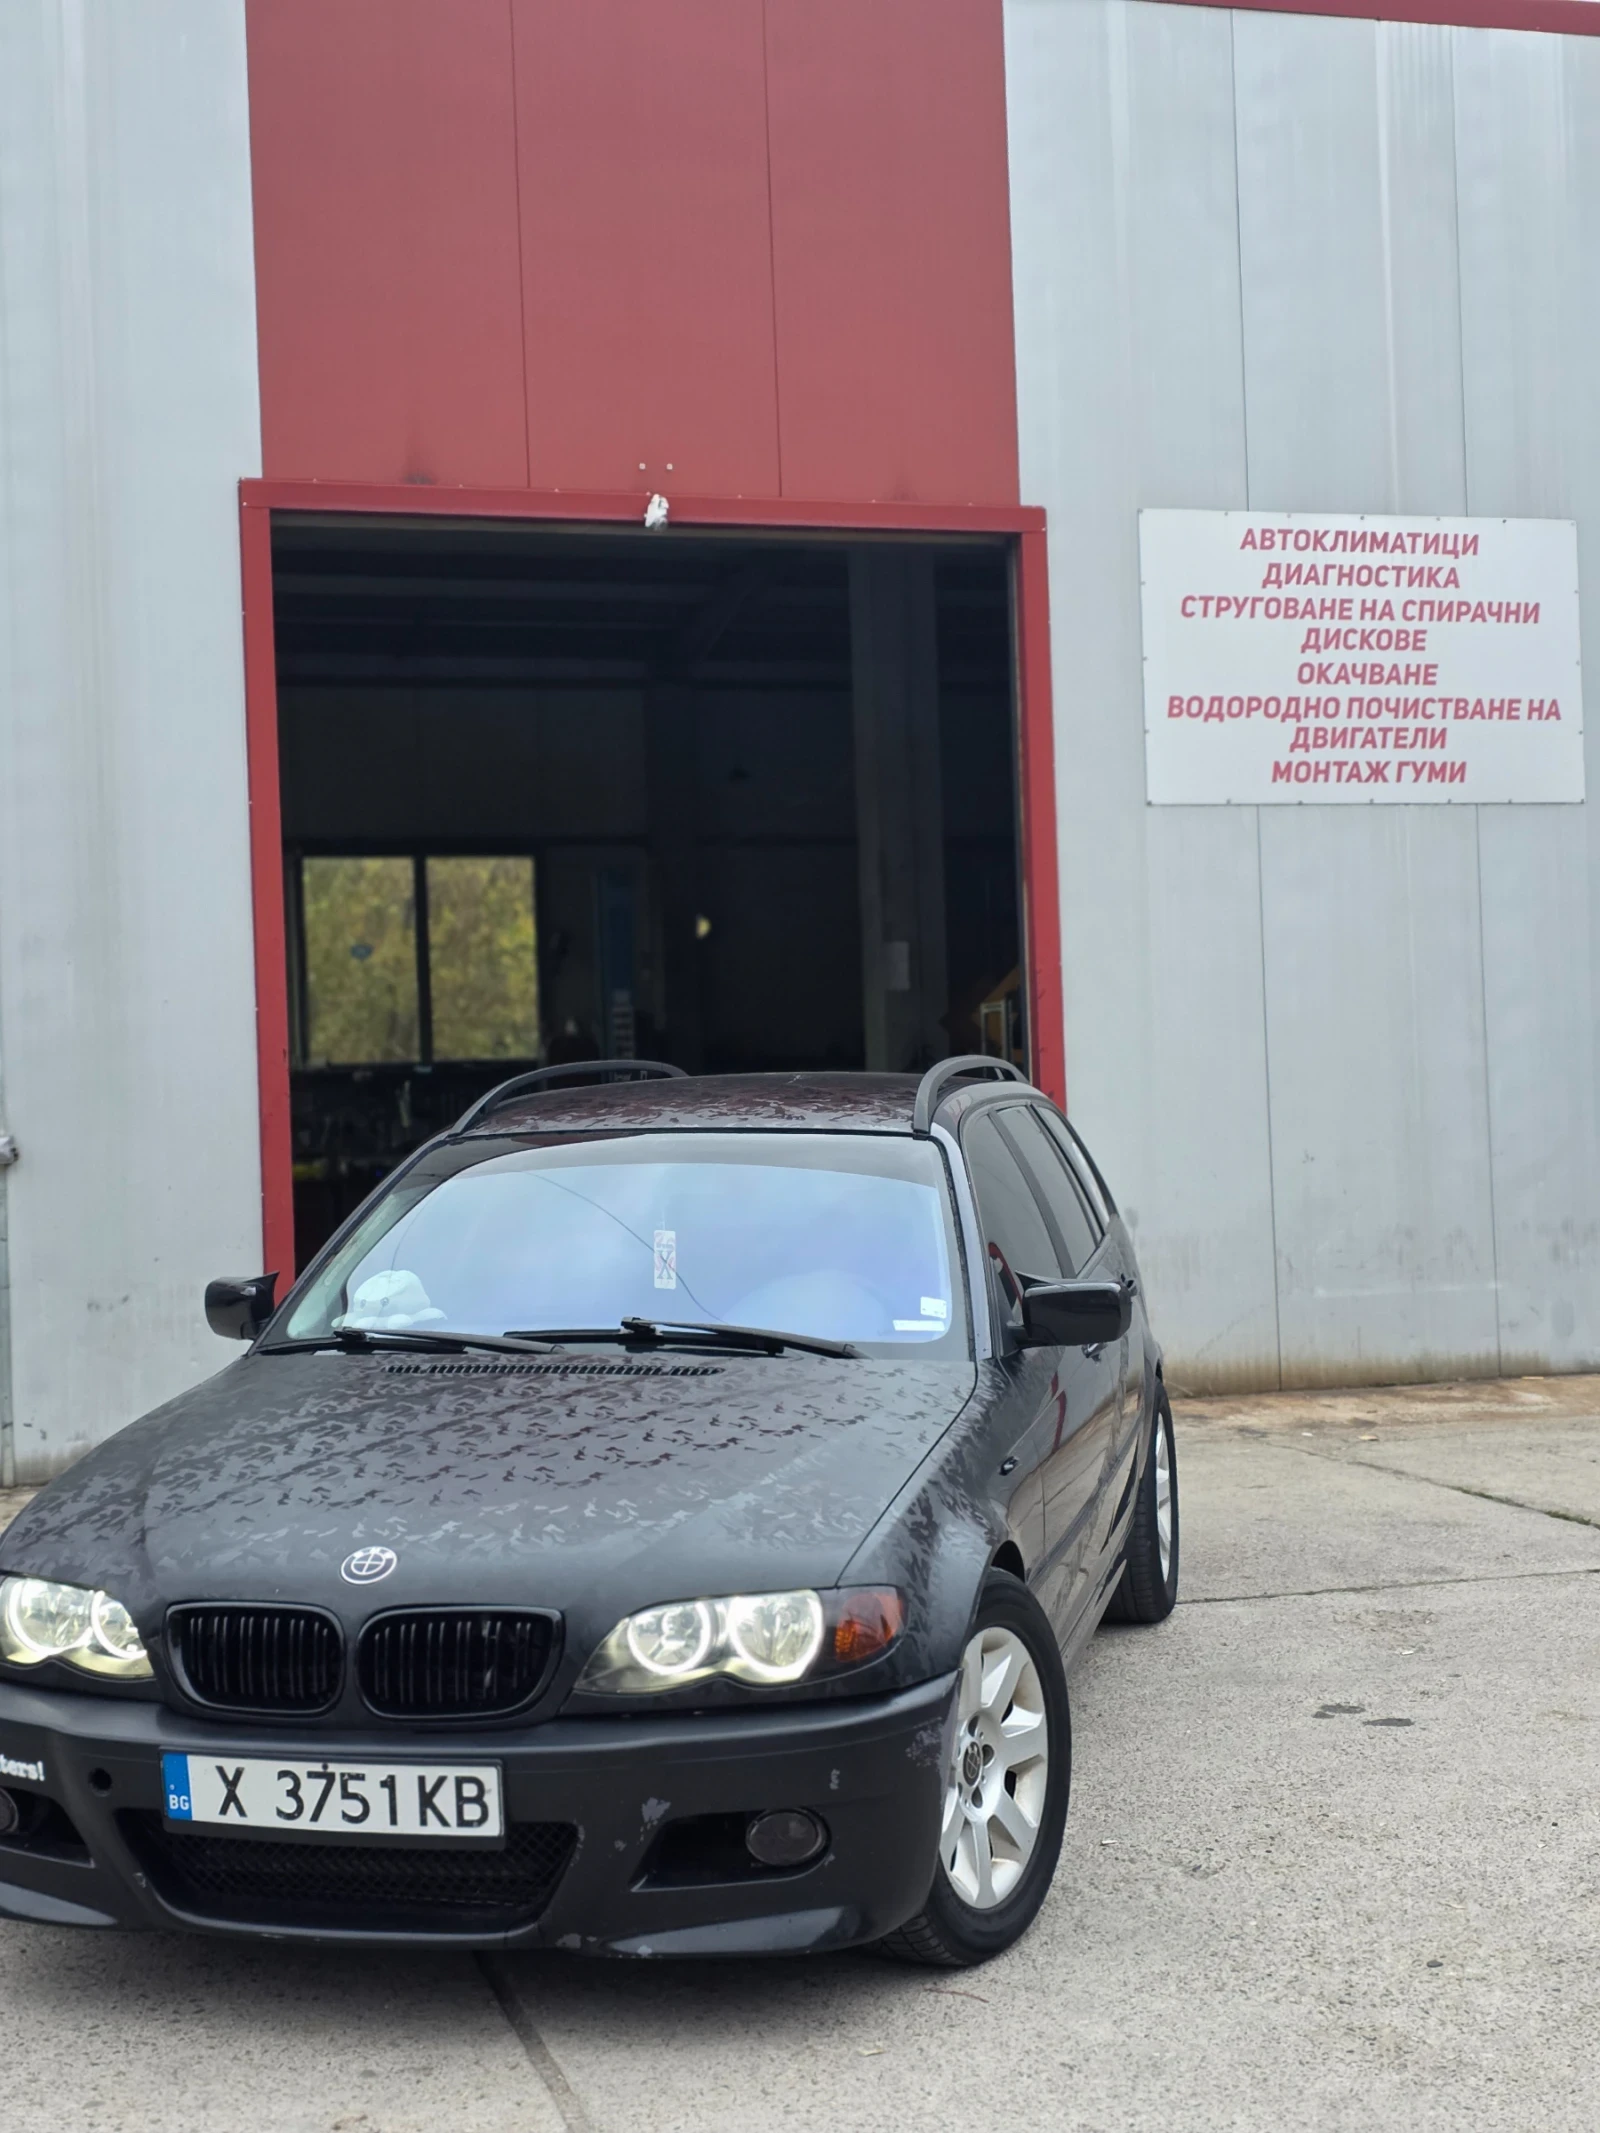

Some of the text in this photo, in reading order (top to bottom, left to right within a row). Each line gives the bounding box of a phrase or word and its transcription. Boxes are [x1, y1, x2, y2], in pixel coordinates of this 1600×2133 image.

[1240, 528, 1479, 558] АВТОКЛИМАТИЦИ
[1262, 563, 1460, 588] ДИАГНОСТИКА
[1181, 595, 1540, 623] СТРУГОВАНЕ НА СПИРАЧНИ
[1300, 628, 1427, 653] ДИСКОВЕ
[1297, 662, 1438, 685] ОКАЧВАНЕ
[1167, 695, 1561, 722] ВОДОРОДНО ПОЧИСТВАНЕ НА
[1289, 726, 1447, 752] ДВИГАТЕЛИ
[1271, 761, 1466, 783] МОНТАЖ ГУМИ
[169, 1794, 190, 1811] BG
